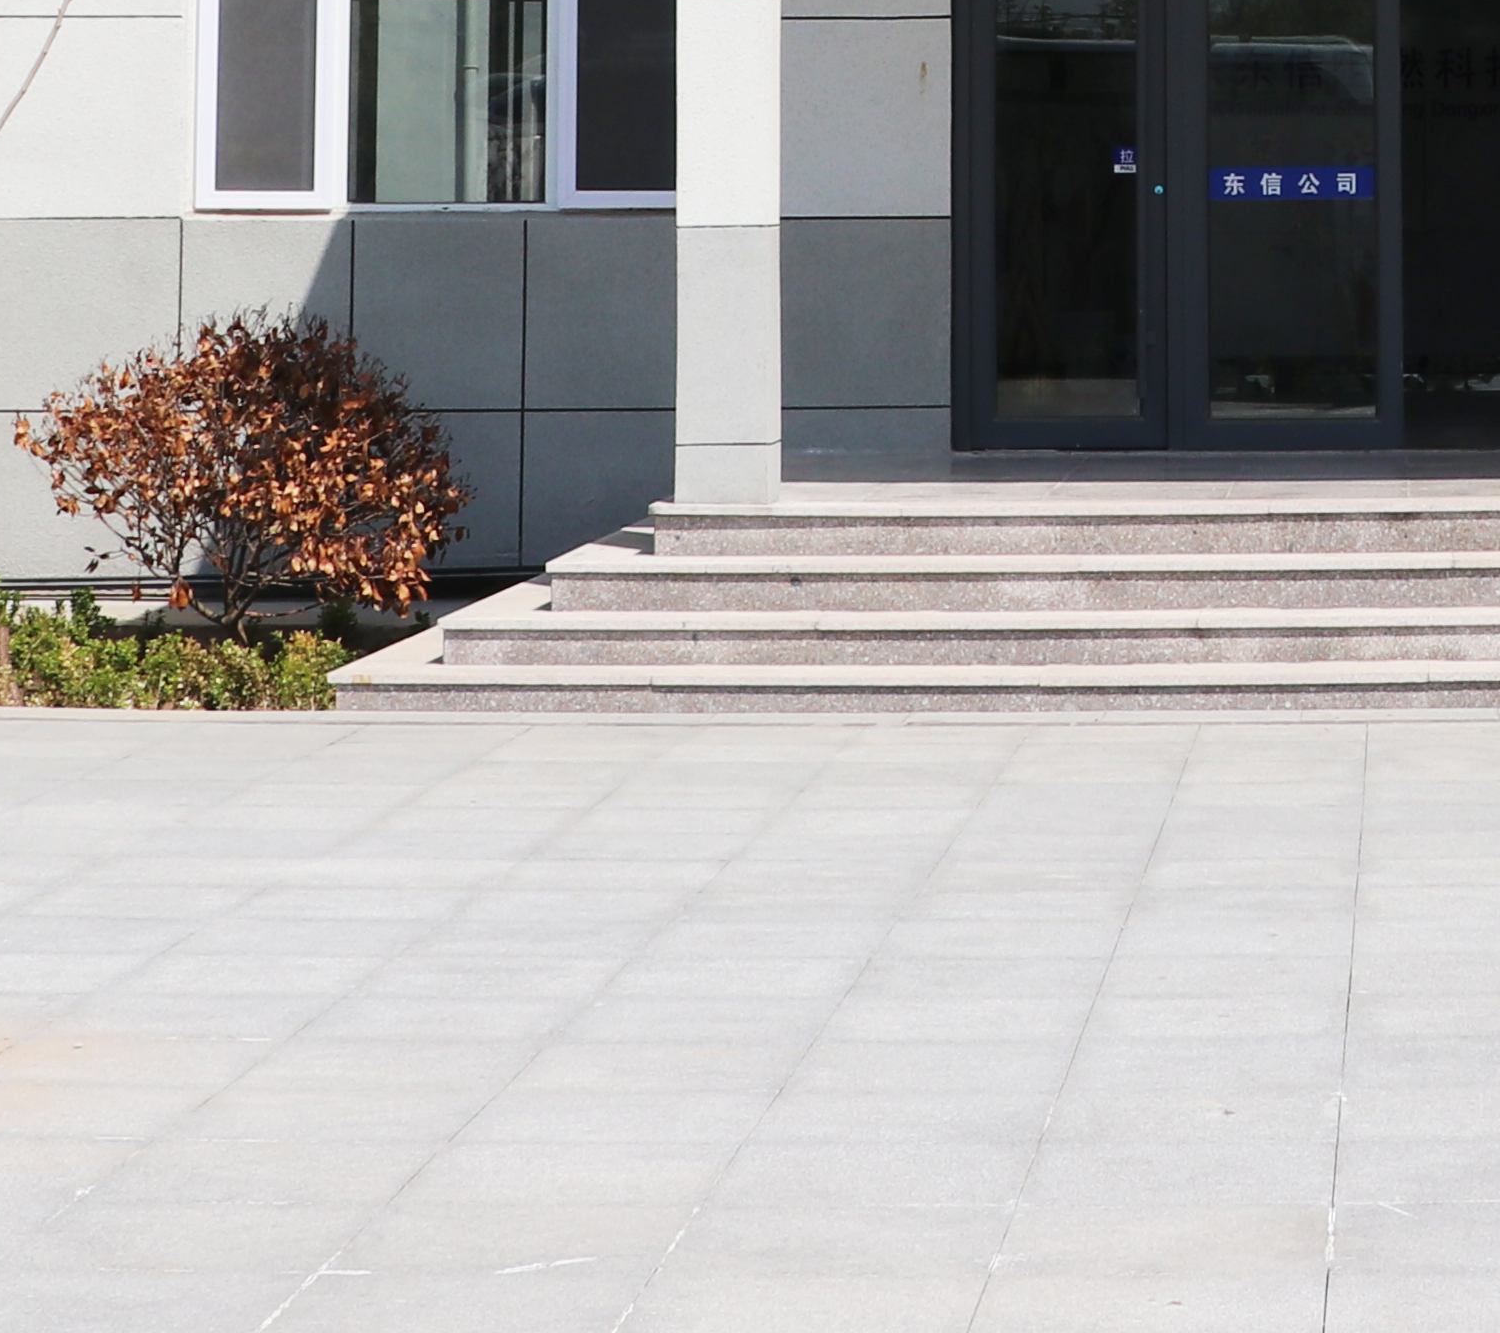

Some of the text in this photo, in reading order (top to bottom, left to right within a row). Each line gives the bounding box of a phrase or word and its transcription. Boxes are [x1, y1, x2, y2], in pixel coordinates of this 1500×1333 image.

[1120, 149, 1134, 163] 拉
[1223, 172, 1357, 196] 东信公司
